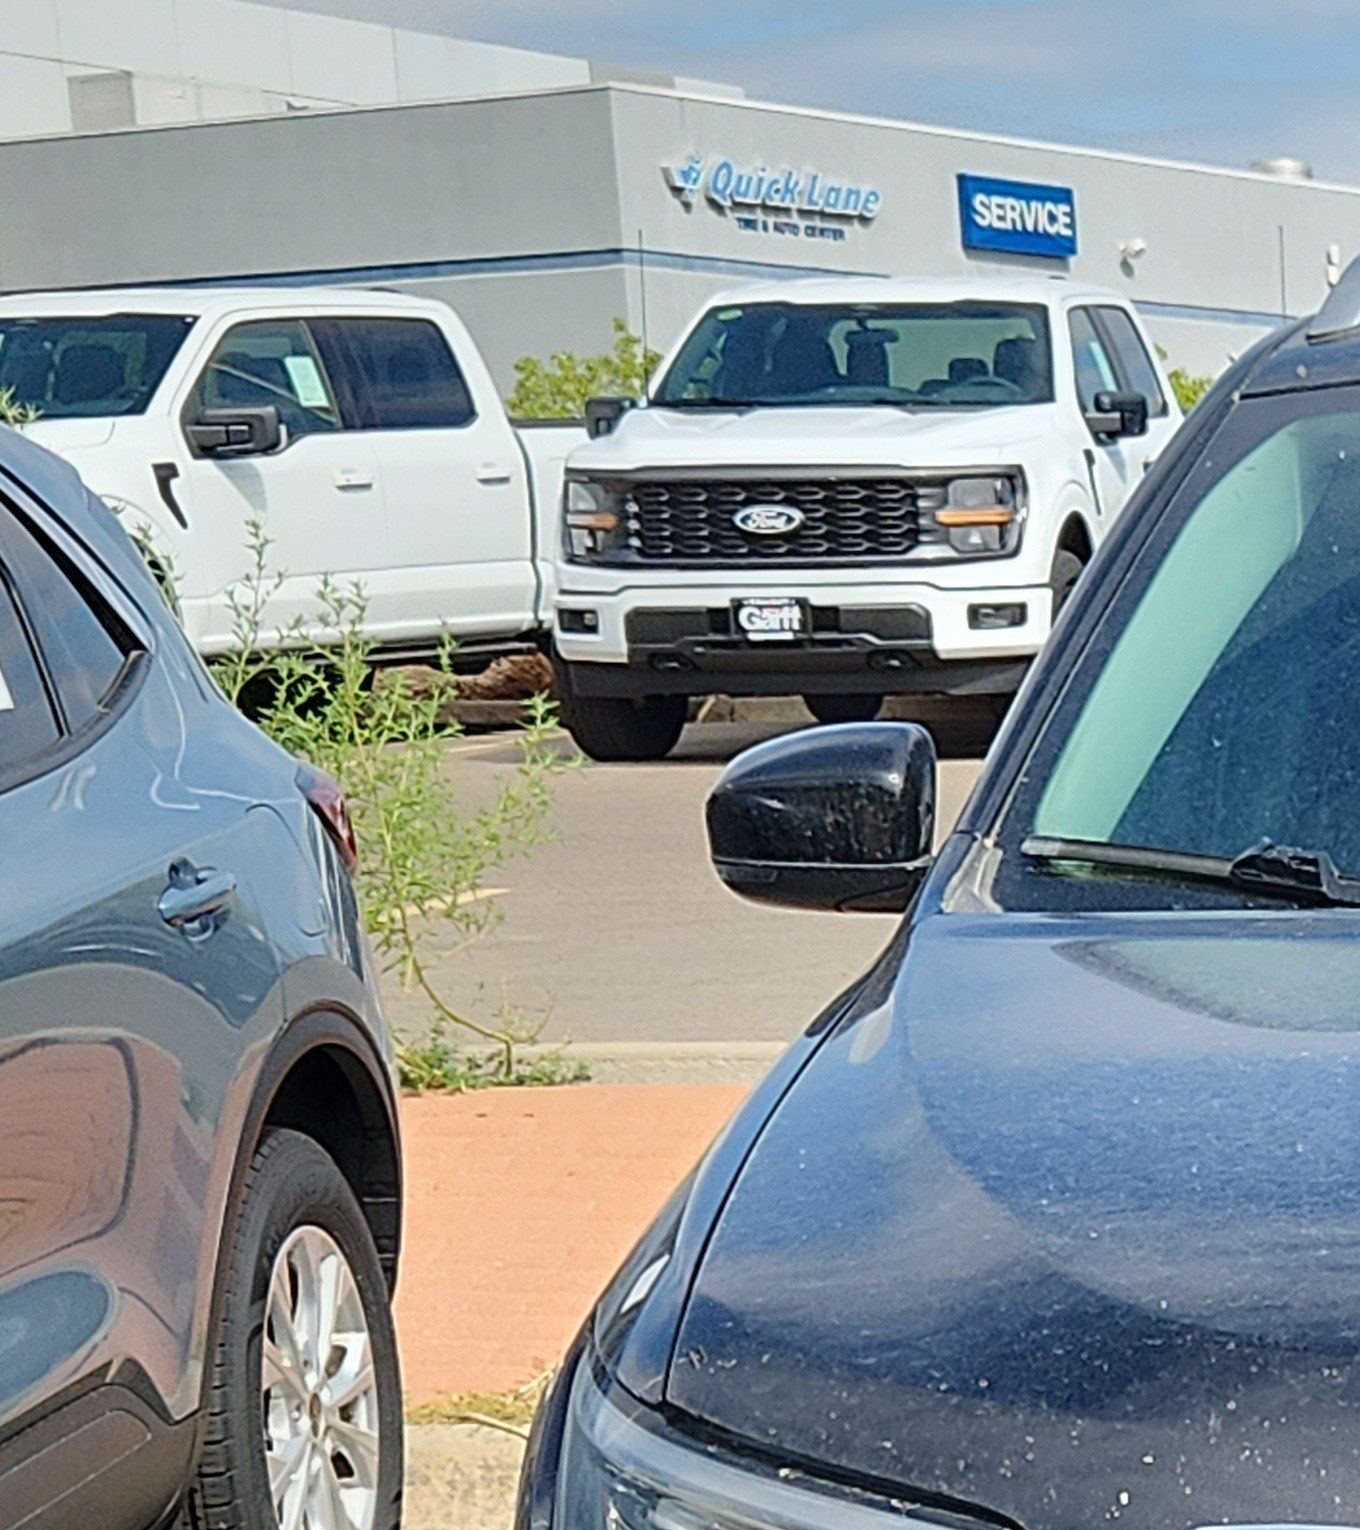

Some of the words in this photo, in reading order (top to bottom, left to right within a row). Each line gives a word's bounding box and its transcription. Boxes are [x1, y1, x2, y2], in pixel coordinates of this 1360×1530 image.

[709, 158, 800, 203] Quick
[806, 173, 882, 216] Lane
[971, 193, 1073, 237] SERVICE
